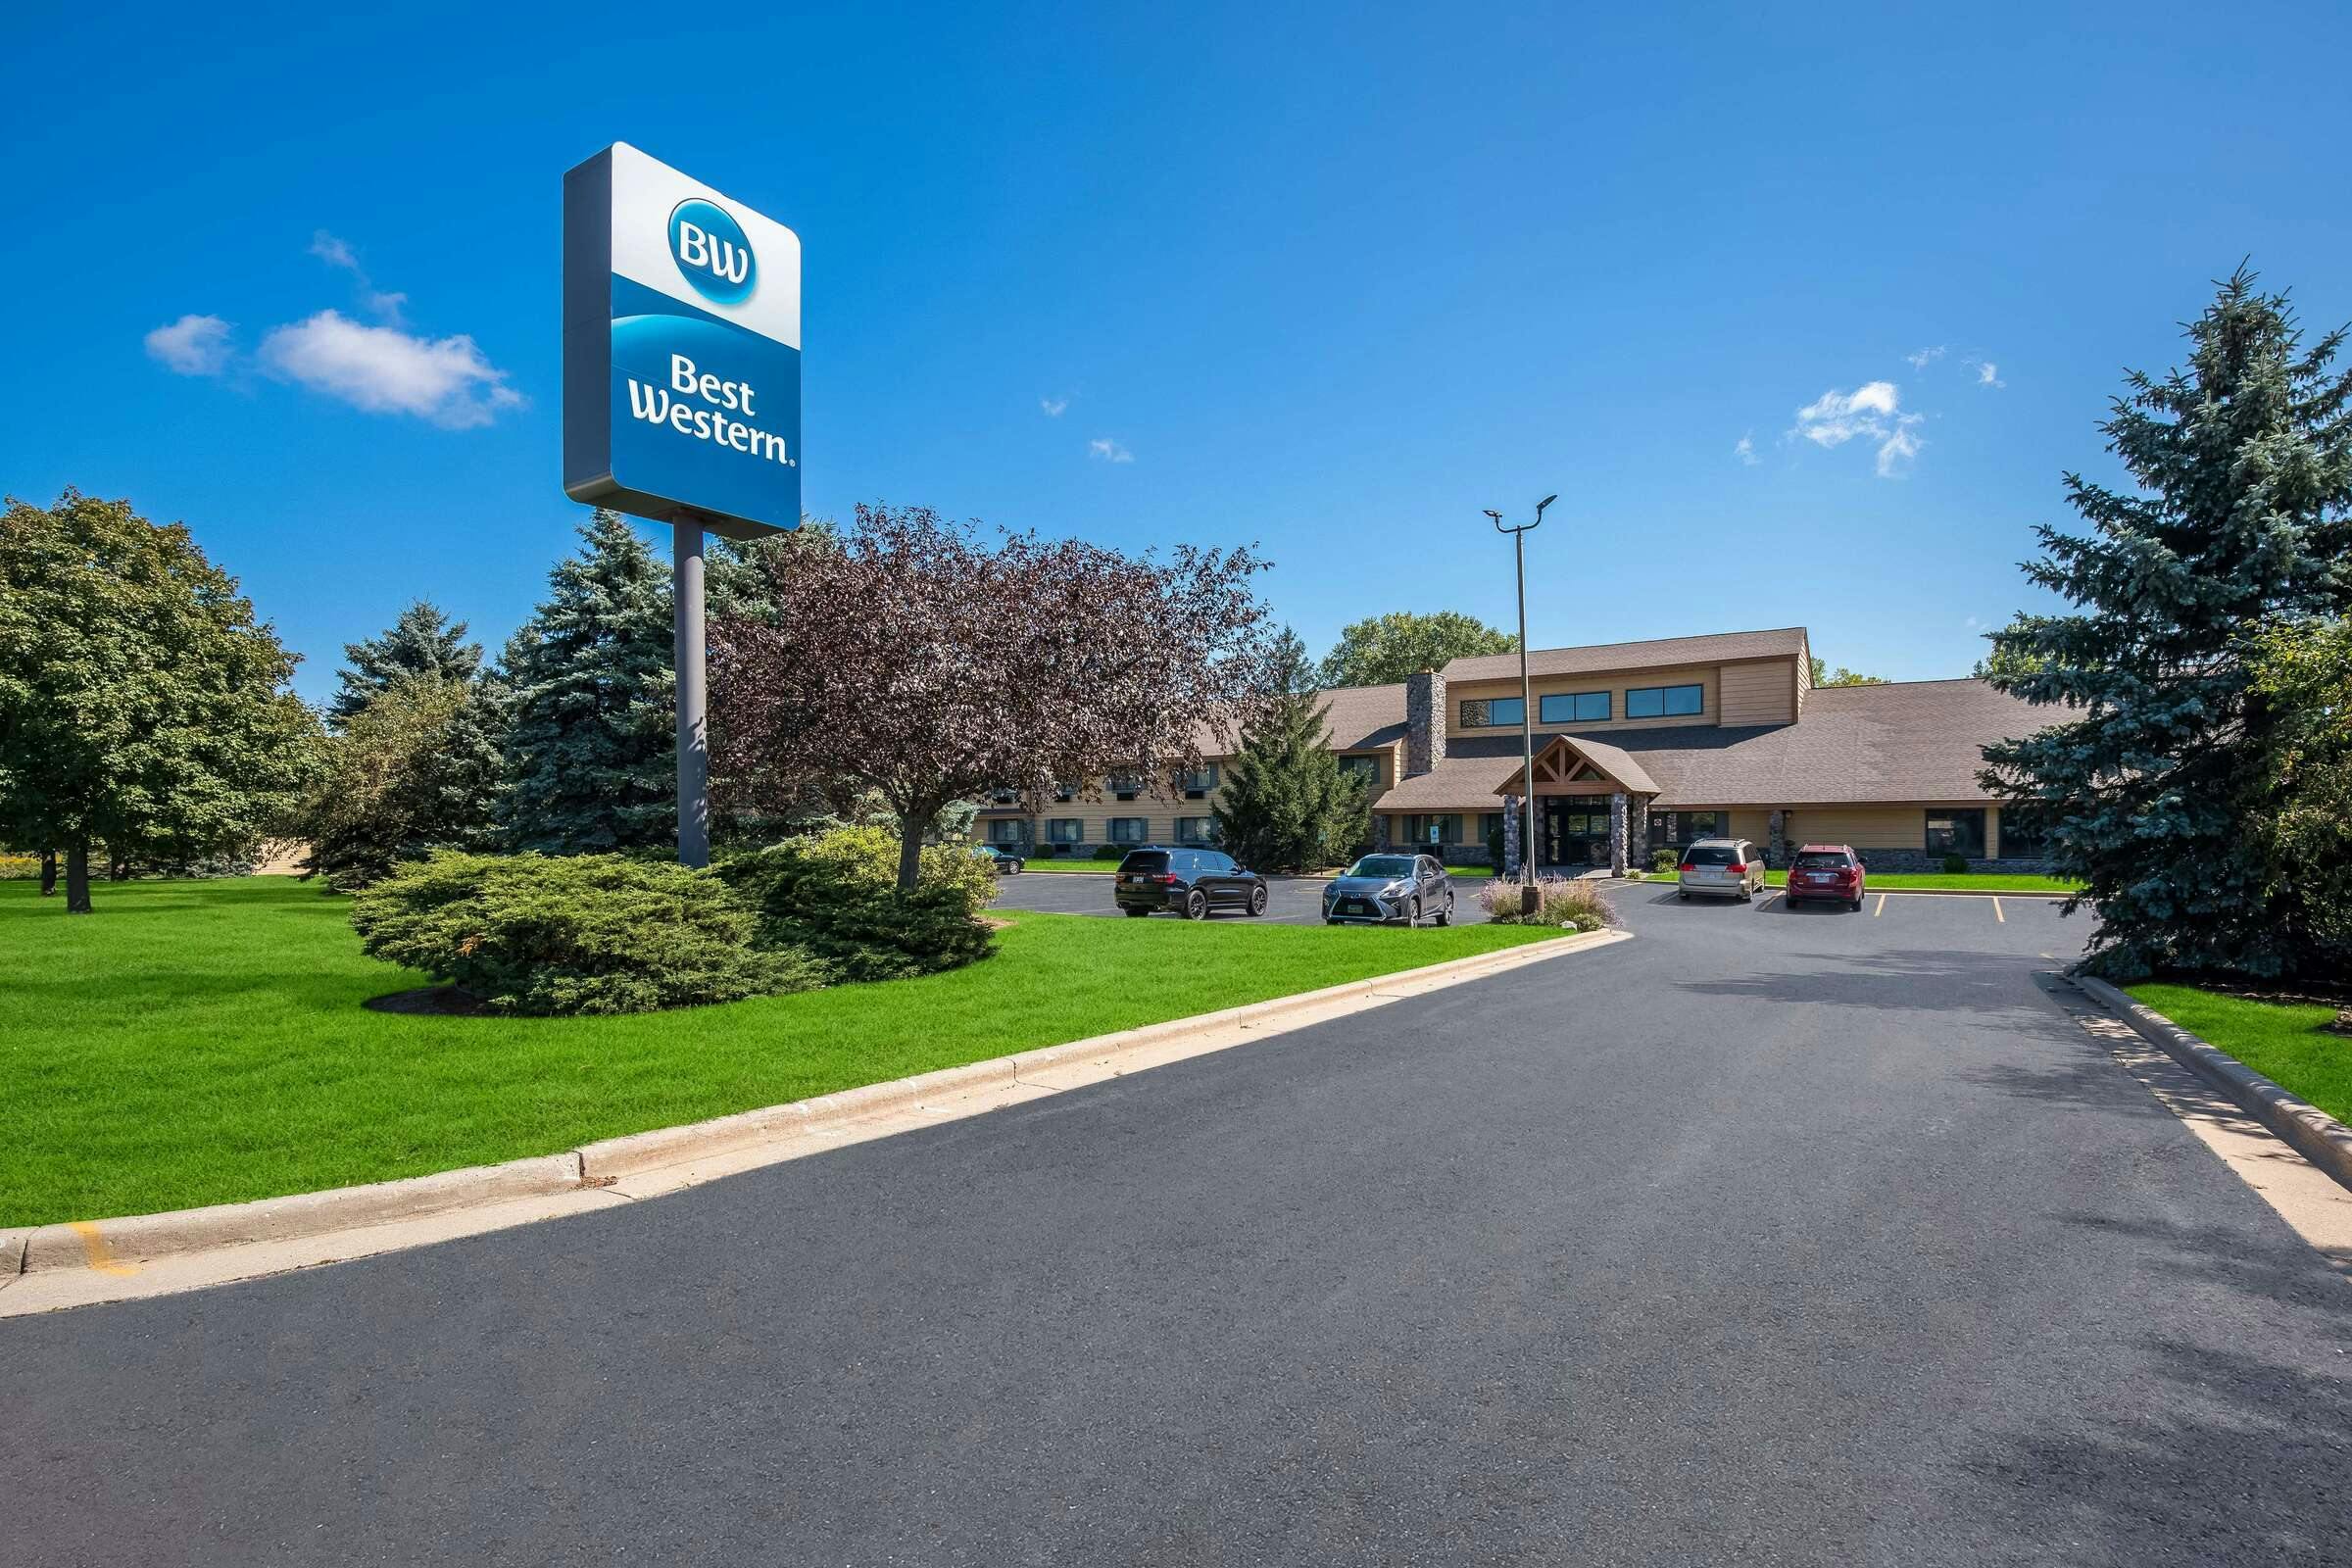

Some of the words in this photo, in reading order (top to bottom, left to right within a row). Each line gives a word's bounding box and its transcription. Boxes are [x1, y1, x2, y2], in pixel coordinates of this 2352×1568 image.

[679, 220, 749, 285] BW
[670, 353, 756, 416] Best
[627, 378, 788, 465] Western
